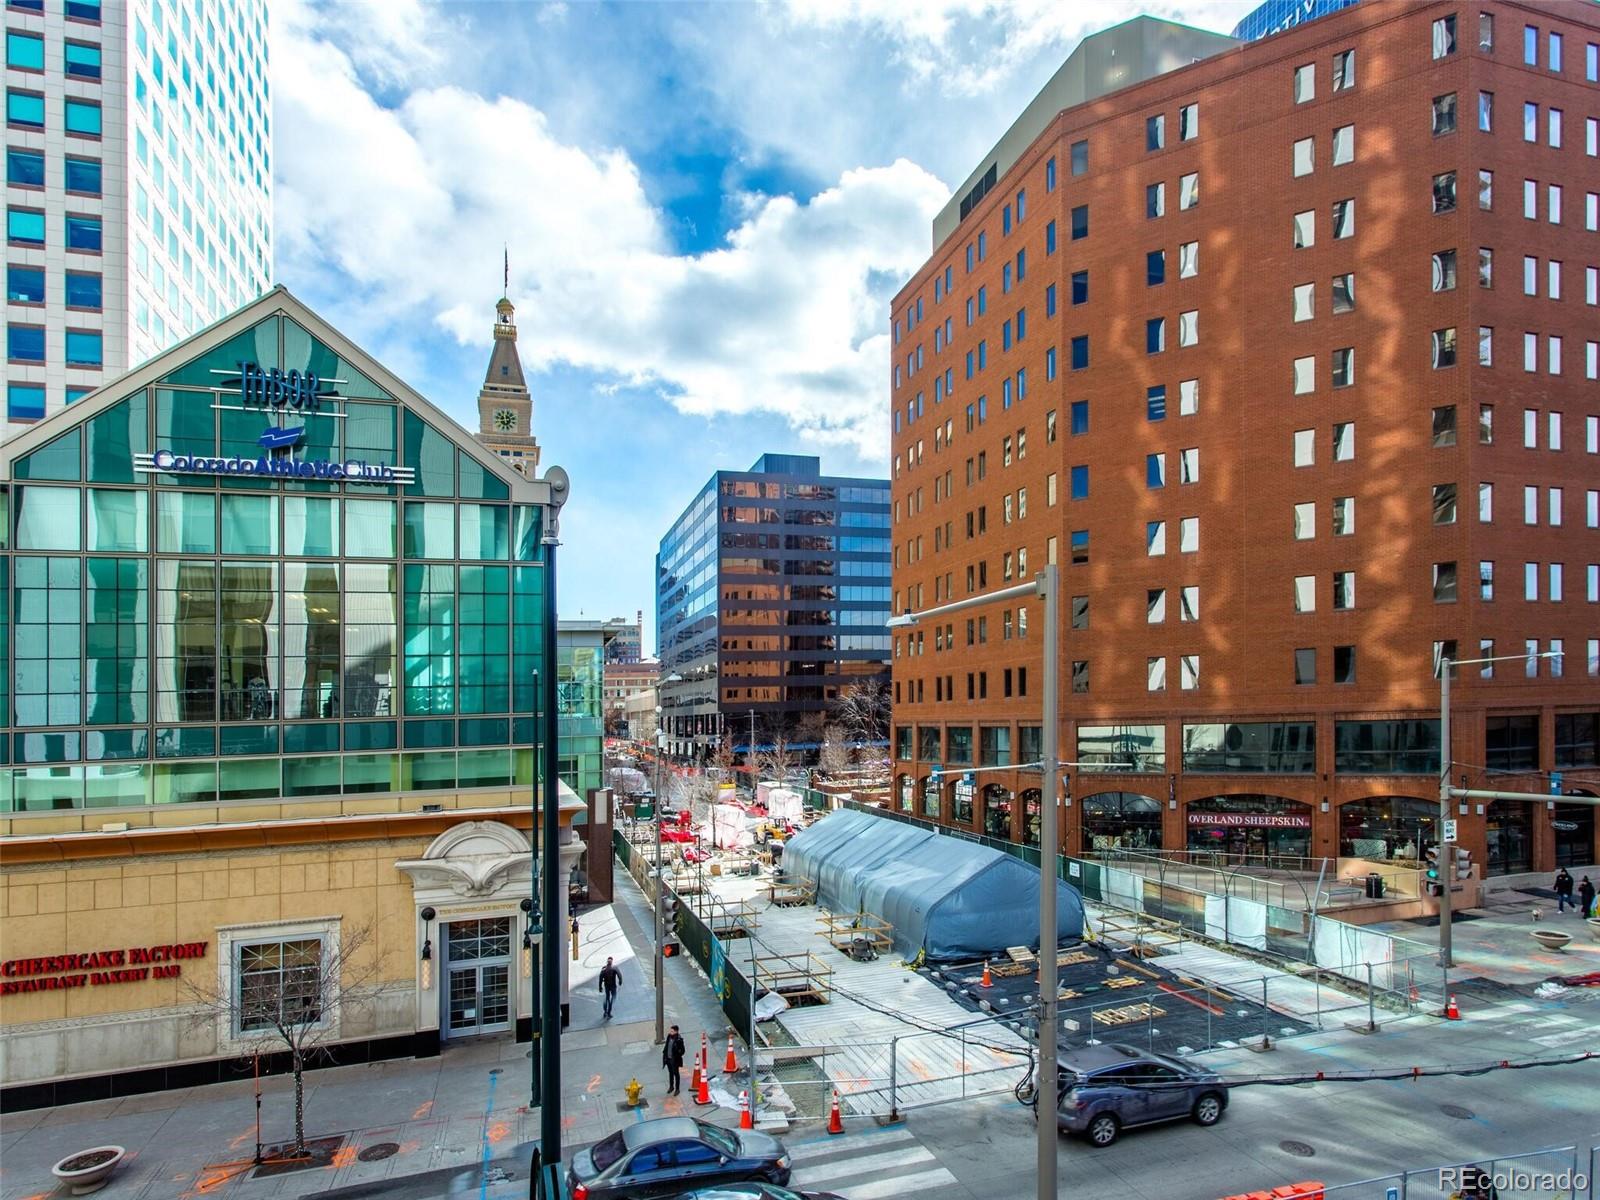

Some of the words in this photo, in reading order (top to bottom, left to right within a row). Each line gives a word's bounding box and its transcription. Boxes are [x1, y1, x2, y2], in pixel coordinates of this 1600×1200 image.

[1188, 815, 1243, 825] OVERLAND
[1244, 816, 1304, 826] SHEEPSKIN
[1, 951, 125, 977] CHEESECAKE
[128, 942, 209, 964] FACTORY
[90, 967, 150, 985] BAKERY
[152, 965, 181, 980] BAR
